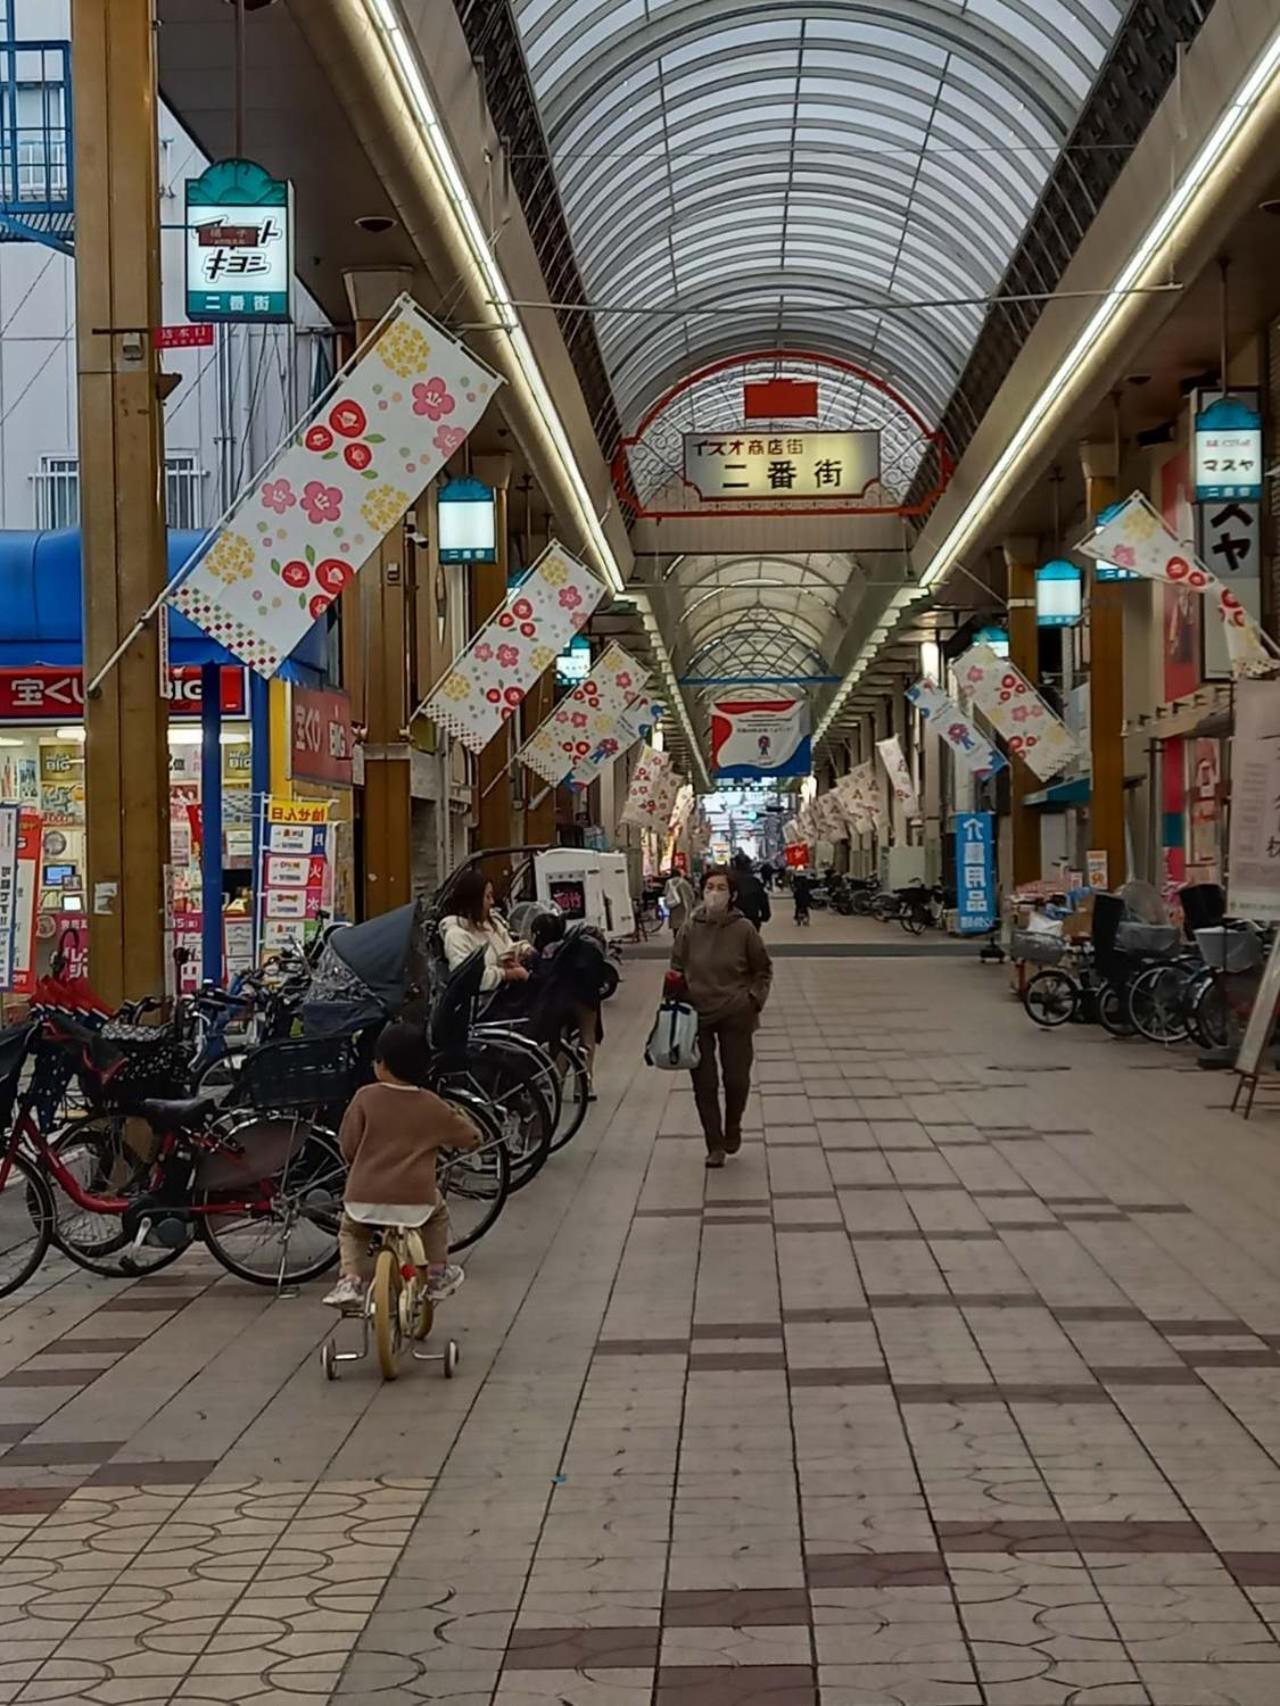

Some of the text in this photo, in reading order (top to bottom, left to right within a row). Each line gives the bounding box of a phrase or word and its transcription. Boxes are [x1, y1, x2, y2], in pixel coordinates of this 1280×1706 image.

[206, 249, 268, 280] キヨシ
[723, 460, 843, 490] 二番街
[1202, 458, 1254, 472] マスヤ
